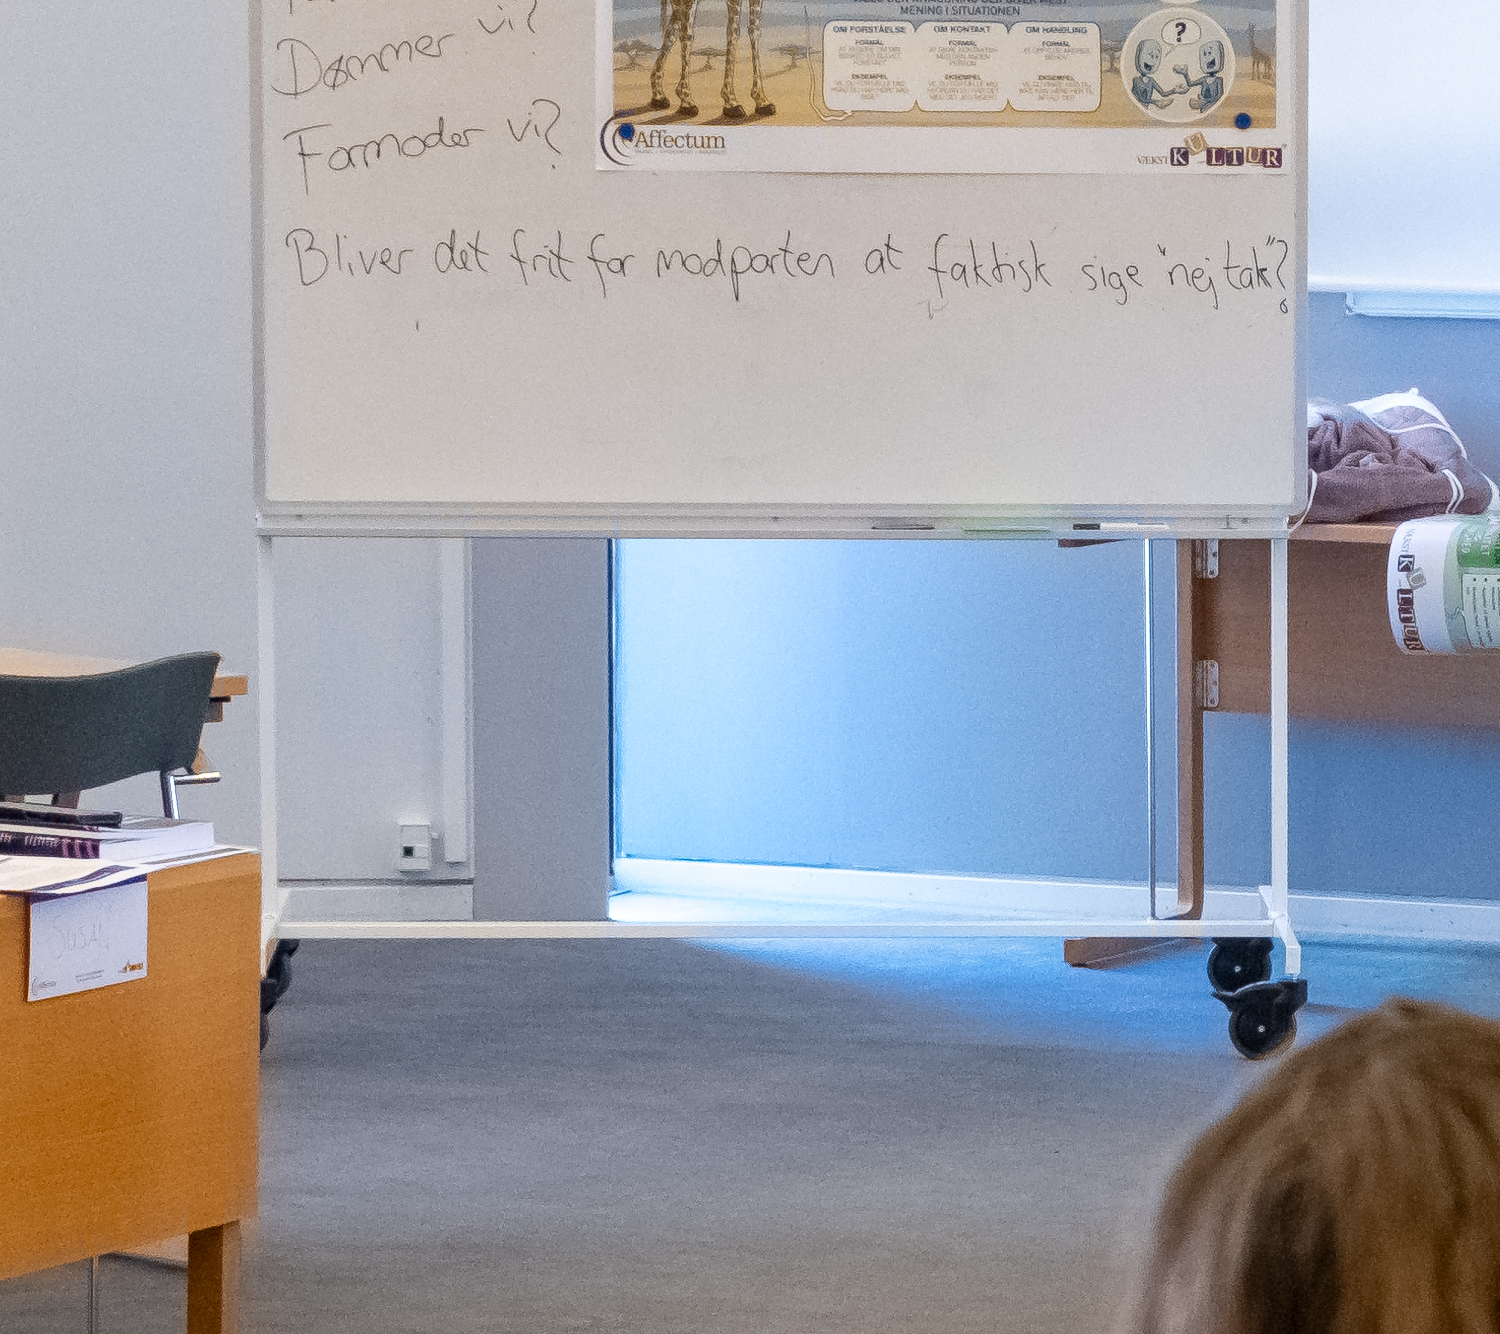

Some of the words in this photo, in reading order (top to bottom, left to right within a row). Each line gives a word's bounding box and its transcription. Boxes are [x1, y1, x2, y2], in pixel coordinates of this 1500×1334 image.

[901, 6, 943, 16] MENING
[952, 6, 1020, 16] SITUATIONEN
[270, 37, 456, 99] Dømmer
[507, 98, 563, 170] vi?
[635, 130, 726, 149] Affectum
[286, 228, 414, 287] Bliver
[434, 228, 489, 274] det
[509, 228, 573, 286] frit
[586, 233, 636, 298] for
[656, 229, 835, 301] modparten
[865, 233, 903, 275] at
[928, 233, 1053, 299] faktisk
[1081, 255, 1144, 306] sige
